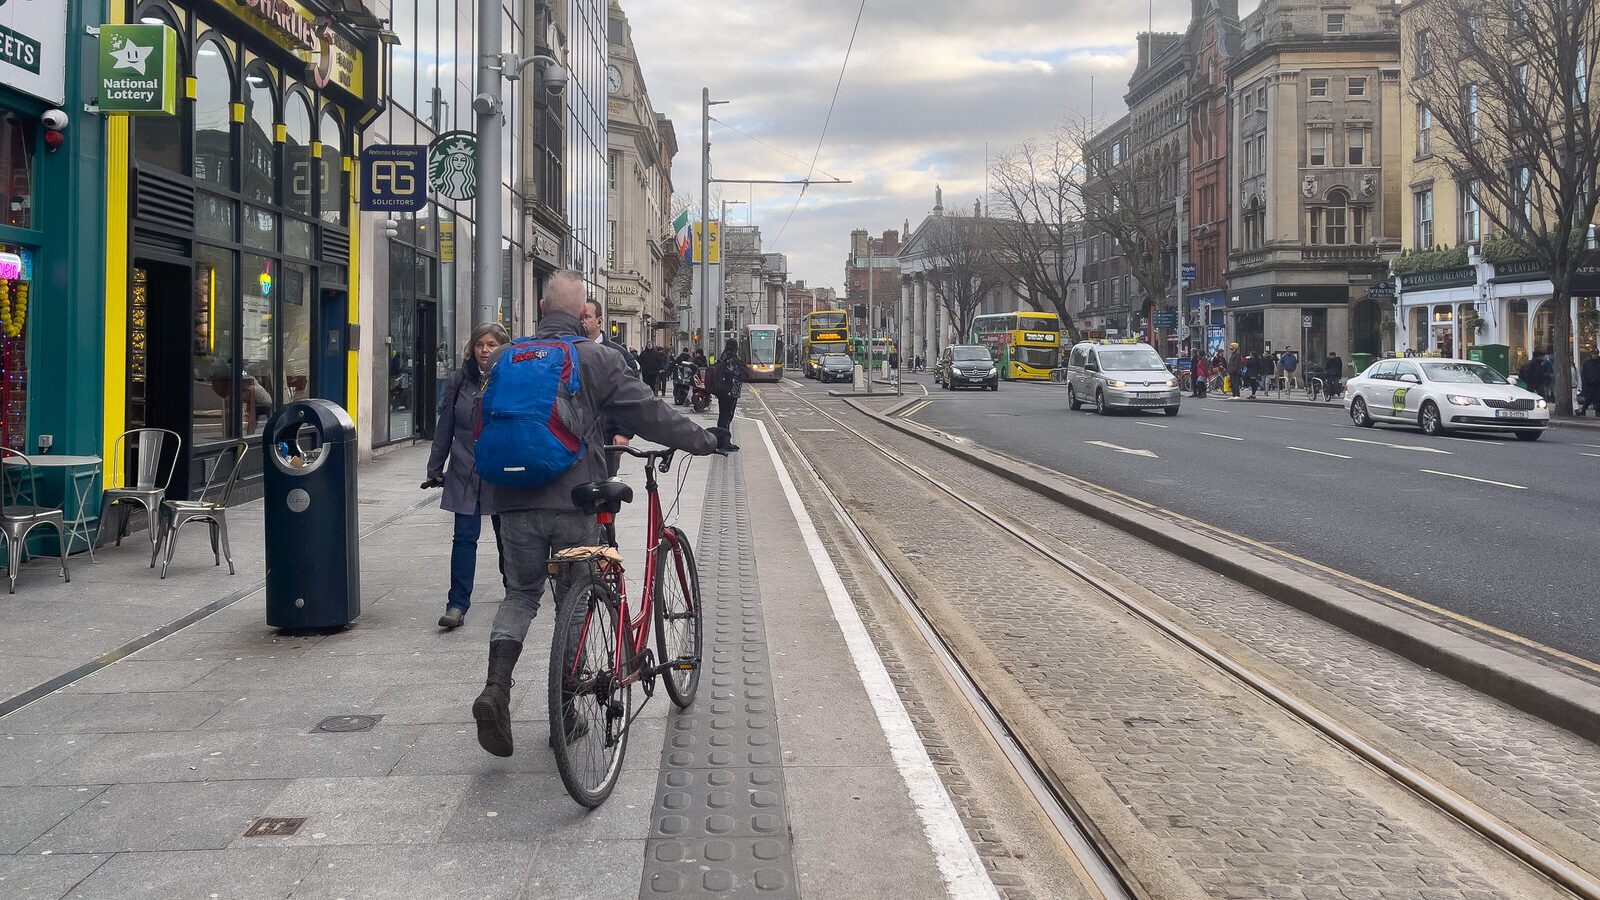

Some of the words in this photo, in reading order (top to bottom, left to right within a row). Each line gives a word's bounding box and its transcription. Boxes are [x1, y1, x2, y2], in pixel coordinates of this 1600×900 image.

[104, 79, 158, 89] National
[107, 89, 154, 102] Lottery
[372, 161, 415, 195] AG
[697, 231, 716, 242] YS
[1508, 262, 1540, 273] WEAVERS
[1410, 274, 1435, 284] WEAVERS
